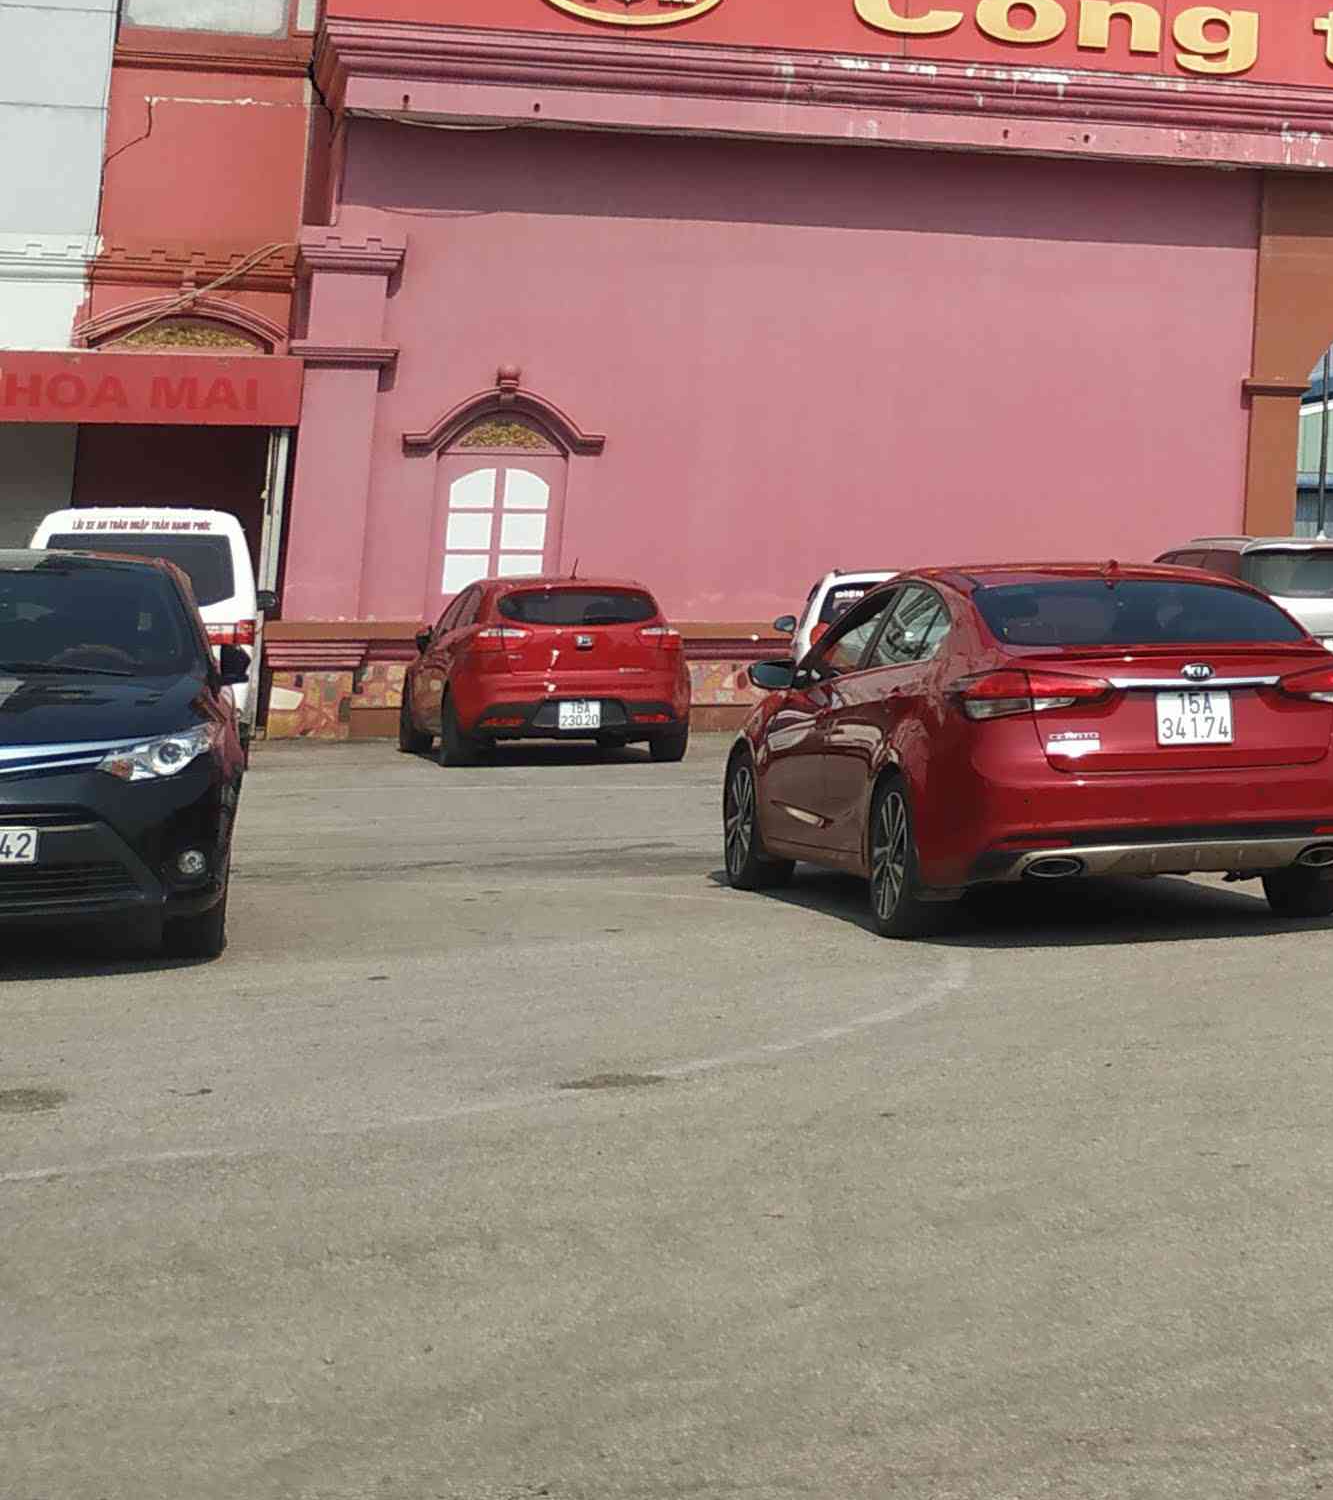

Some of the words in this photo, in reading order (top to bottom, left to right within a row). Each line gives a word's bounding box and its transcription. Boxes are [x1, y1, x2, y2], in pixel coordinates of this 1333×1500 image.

[2, 371, 129, 409] HOA
[150, 375, 260, 412] MAI
[1182, 664, 1212, 678] KIA
[1178, 692, 1213, 715] 15A
[1161, 716, 1230, 740] 341.74
[0, 832, 32, 859] 42
